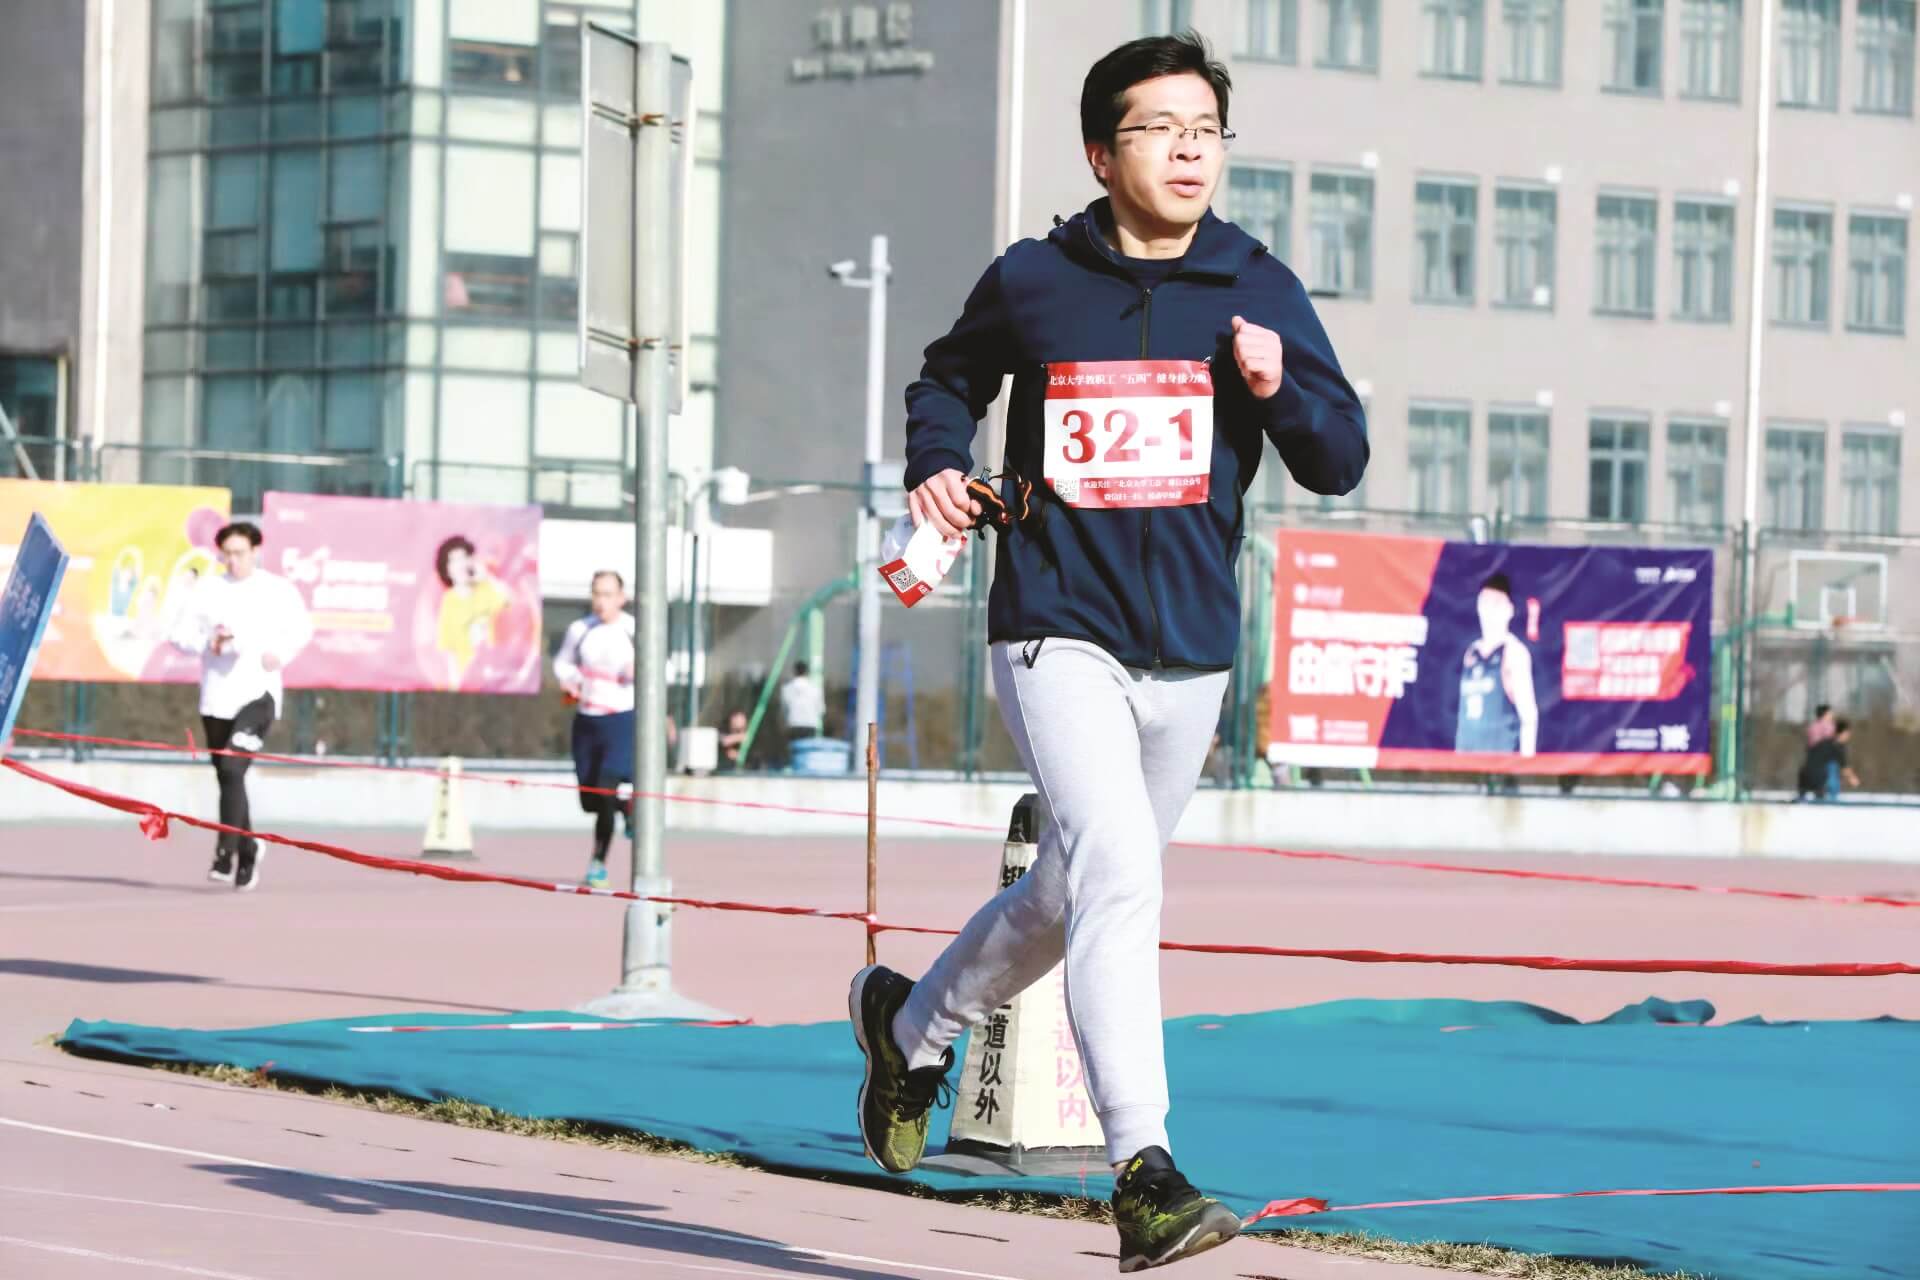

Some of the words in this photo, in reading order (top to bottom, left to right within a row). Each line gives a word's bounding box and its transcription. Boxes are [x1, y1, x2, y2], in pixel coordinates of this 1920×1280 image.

[1062, 408, 1193, 464] 32-1
[974, 1001, 1012, 1125] 道以外
